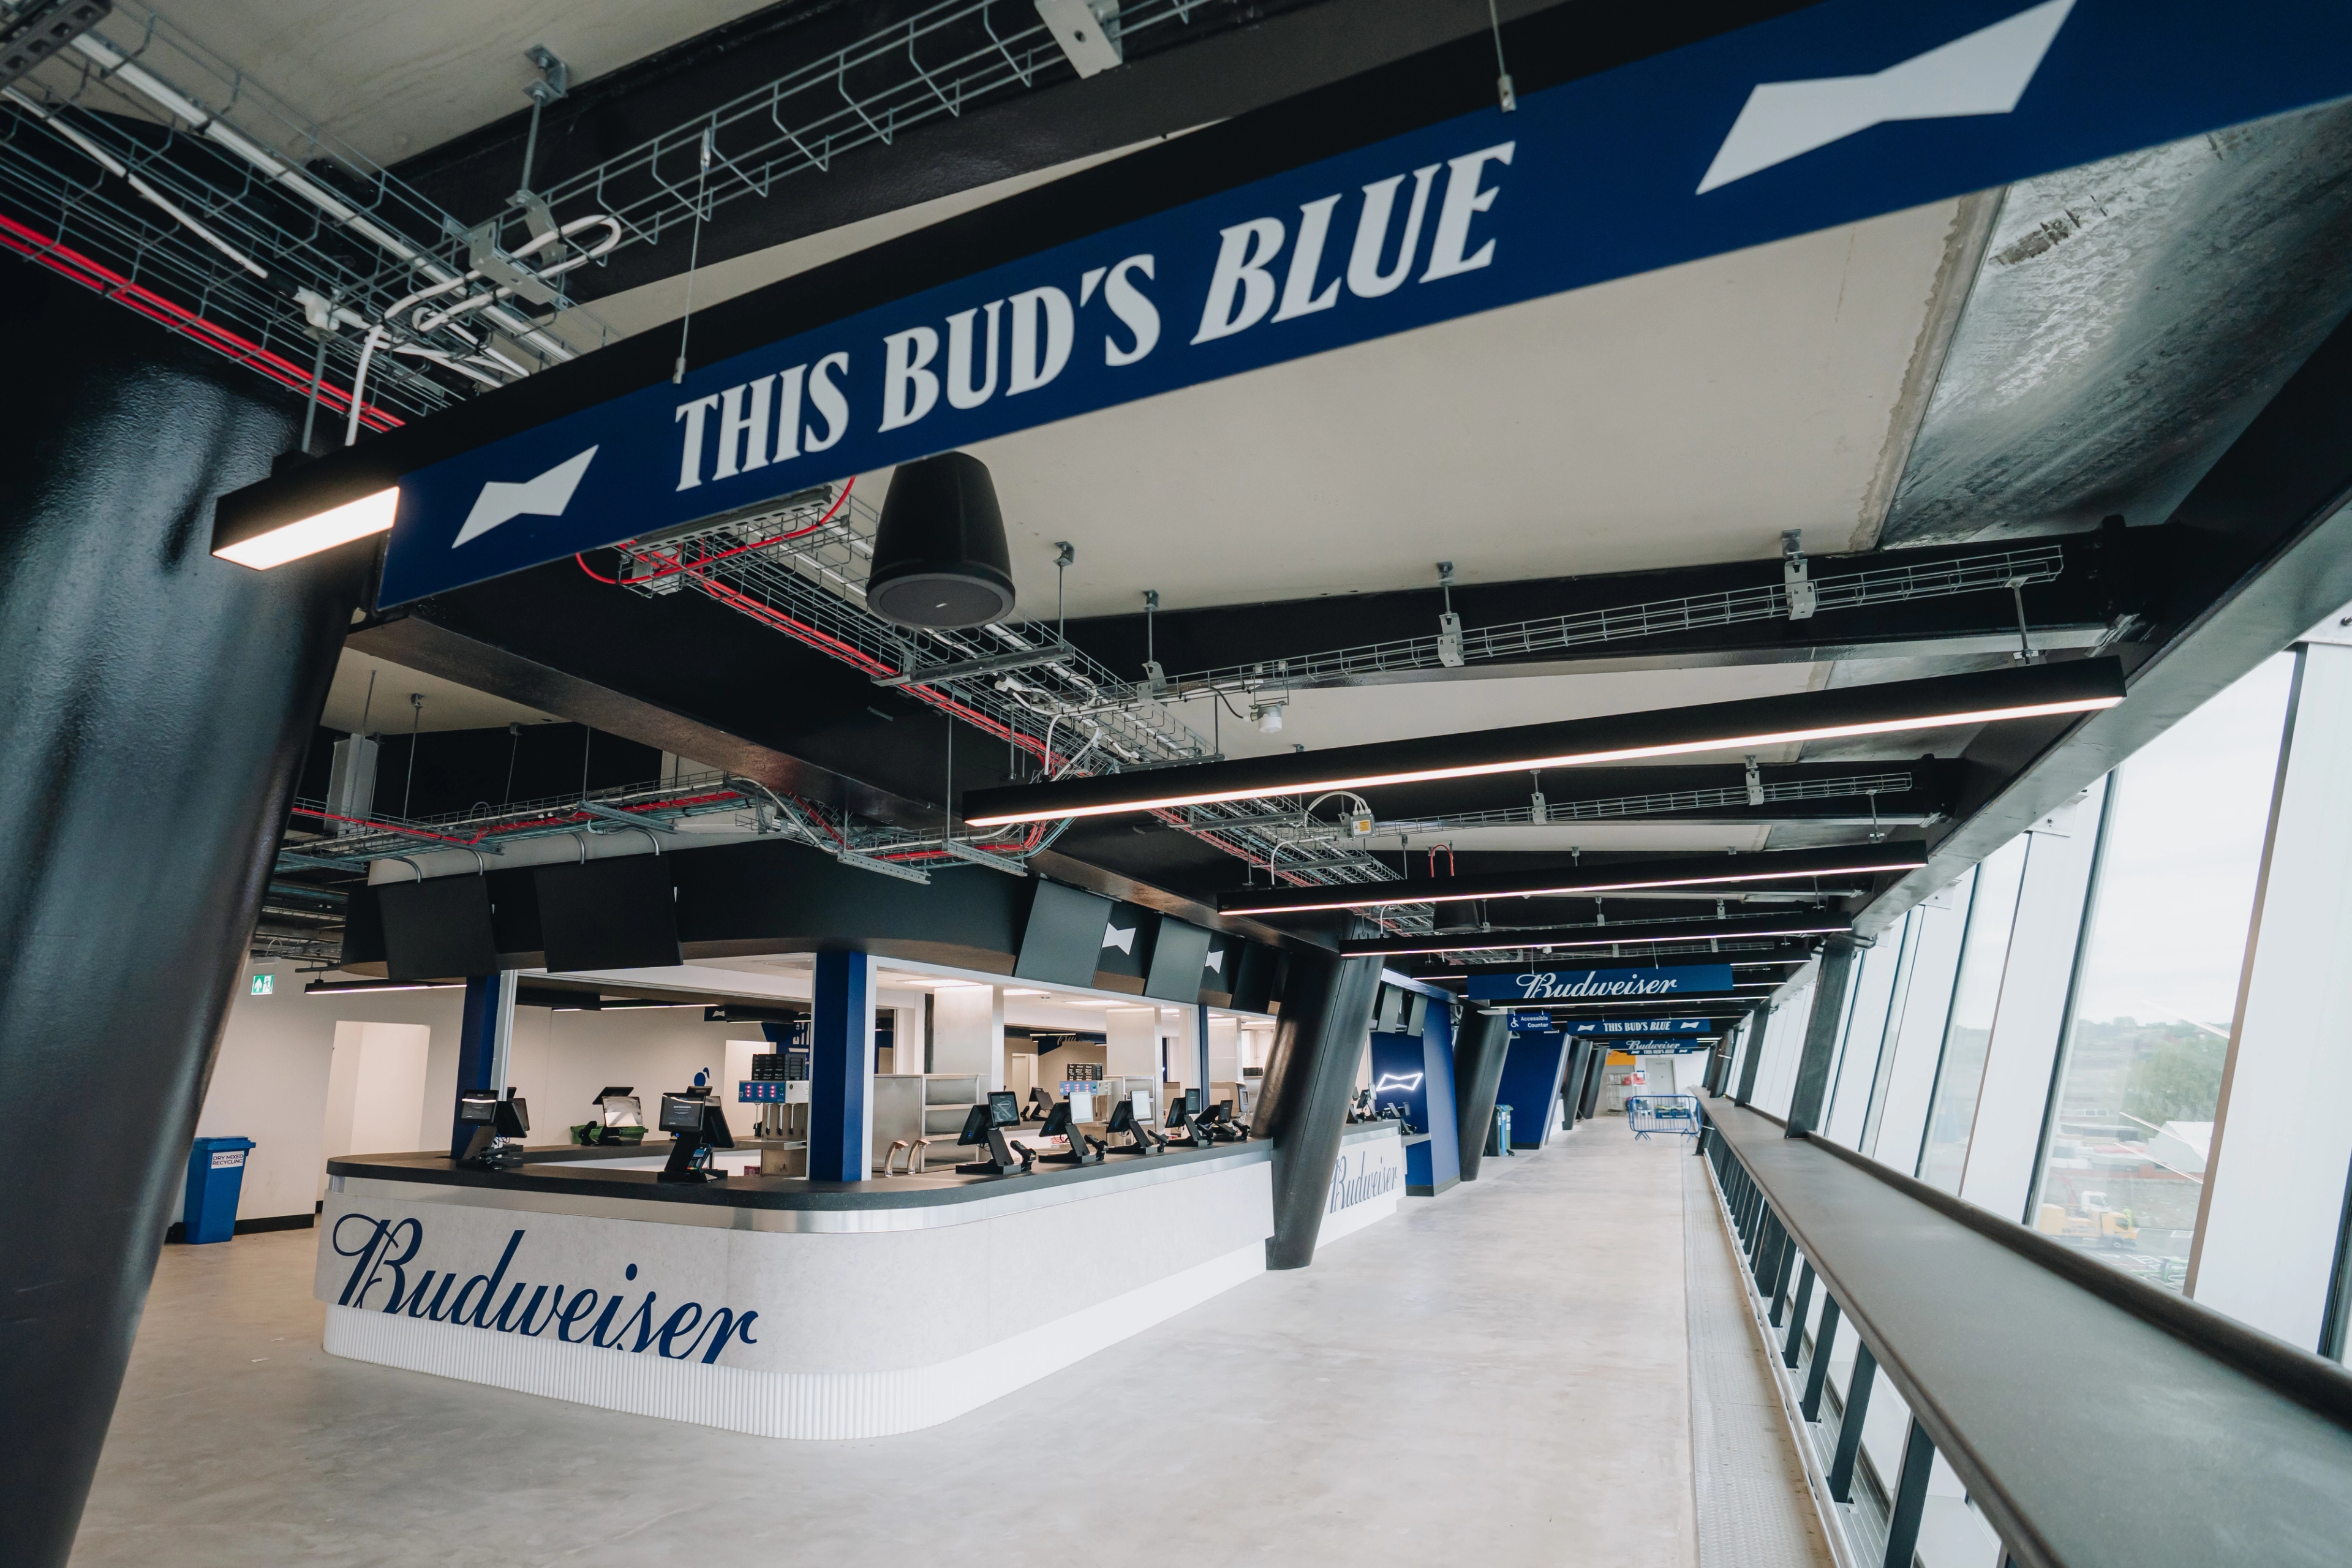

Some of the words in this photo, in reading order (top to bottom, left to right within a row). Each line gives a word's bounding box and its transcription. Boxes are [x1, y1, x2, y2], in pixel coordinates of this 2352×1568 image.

[675, 352, 850, 491] THIS
[878, 254, 1161, 432] BUD'S
[1190, 141, 1516, 345] BLUE
[1516, 971, 1677, 998] Budweiser
[1604, 1023, 1623, 1031] THIS
[1624, 1022, 1648, 1031] BUD'S
[1649, 1022, 1671, 1031] BLUE
[1626, 1040, 1680, 1049] Budweiser
[1330, 1151, 1397, 1214] Budweiser
[333, 1213, 759, 1364] Budweiser
